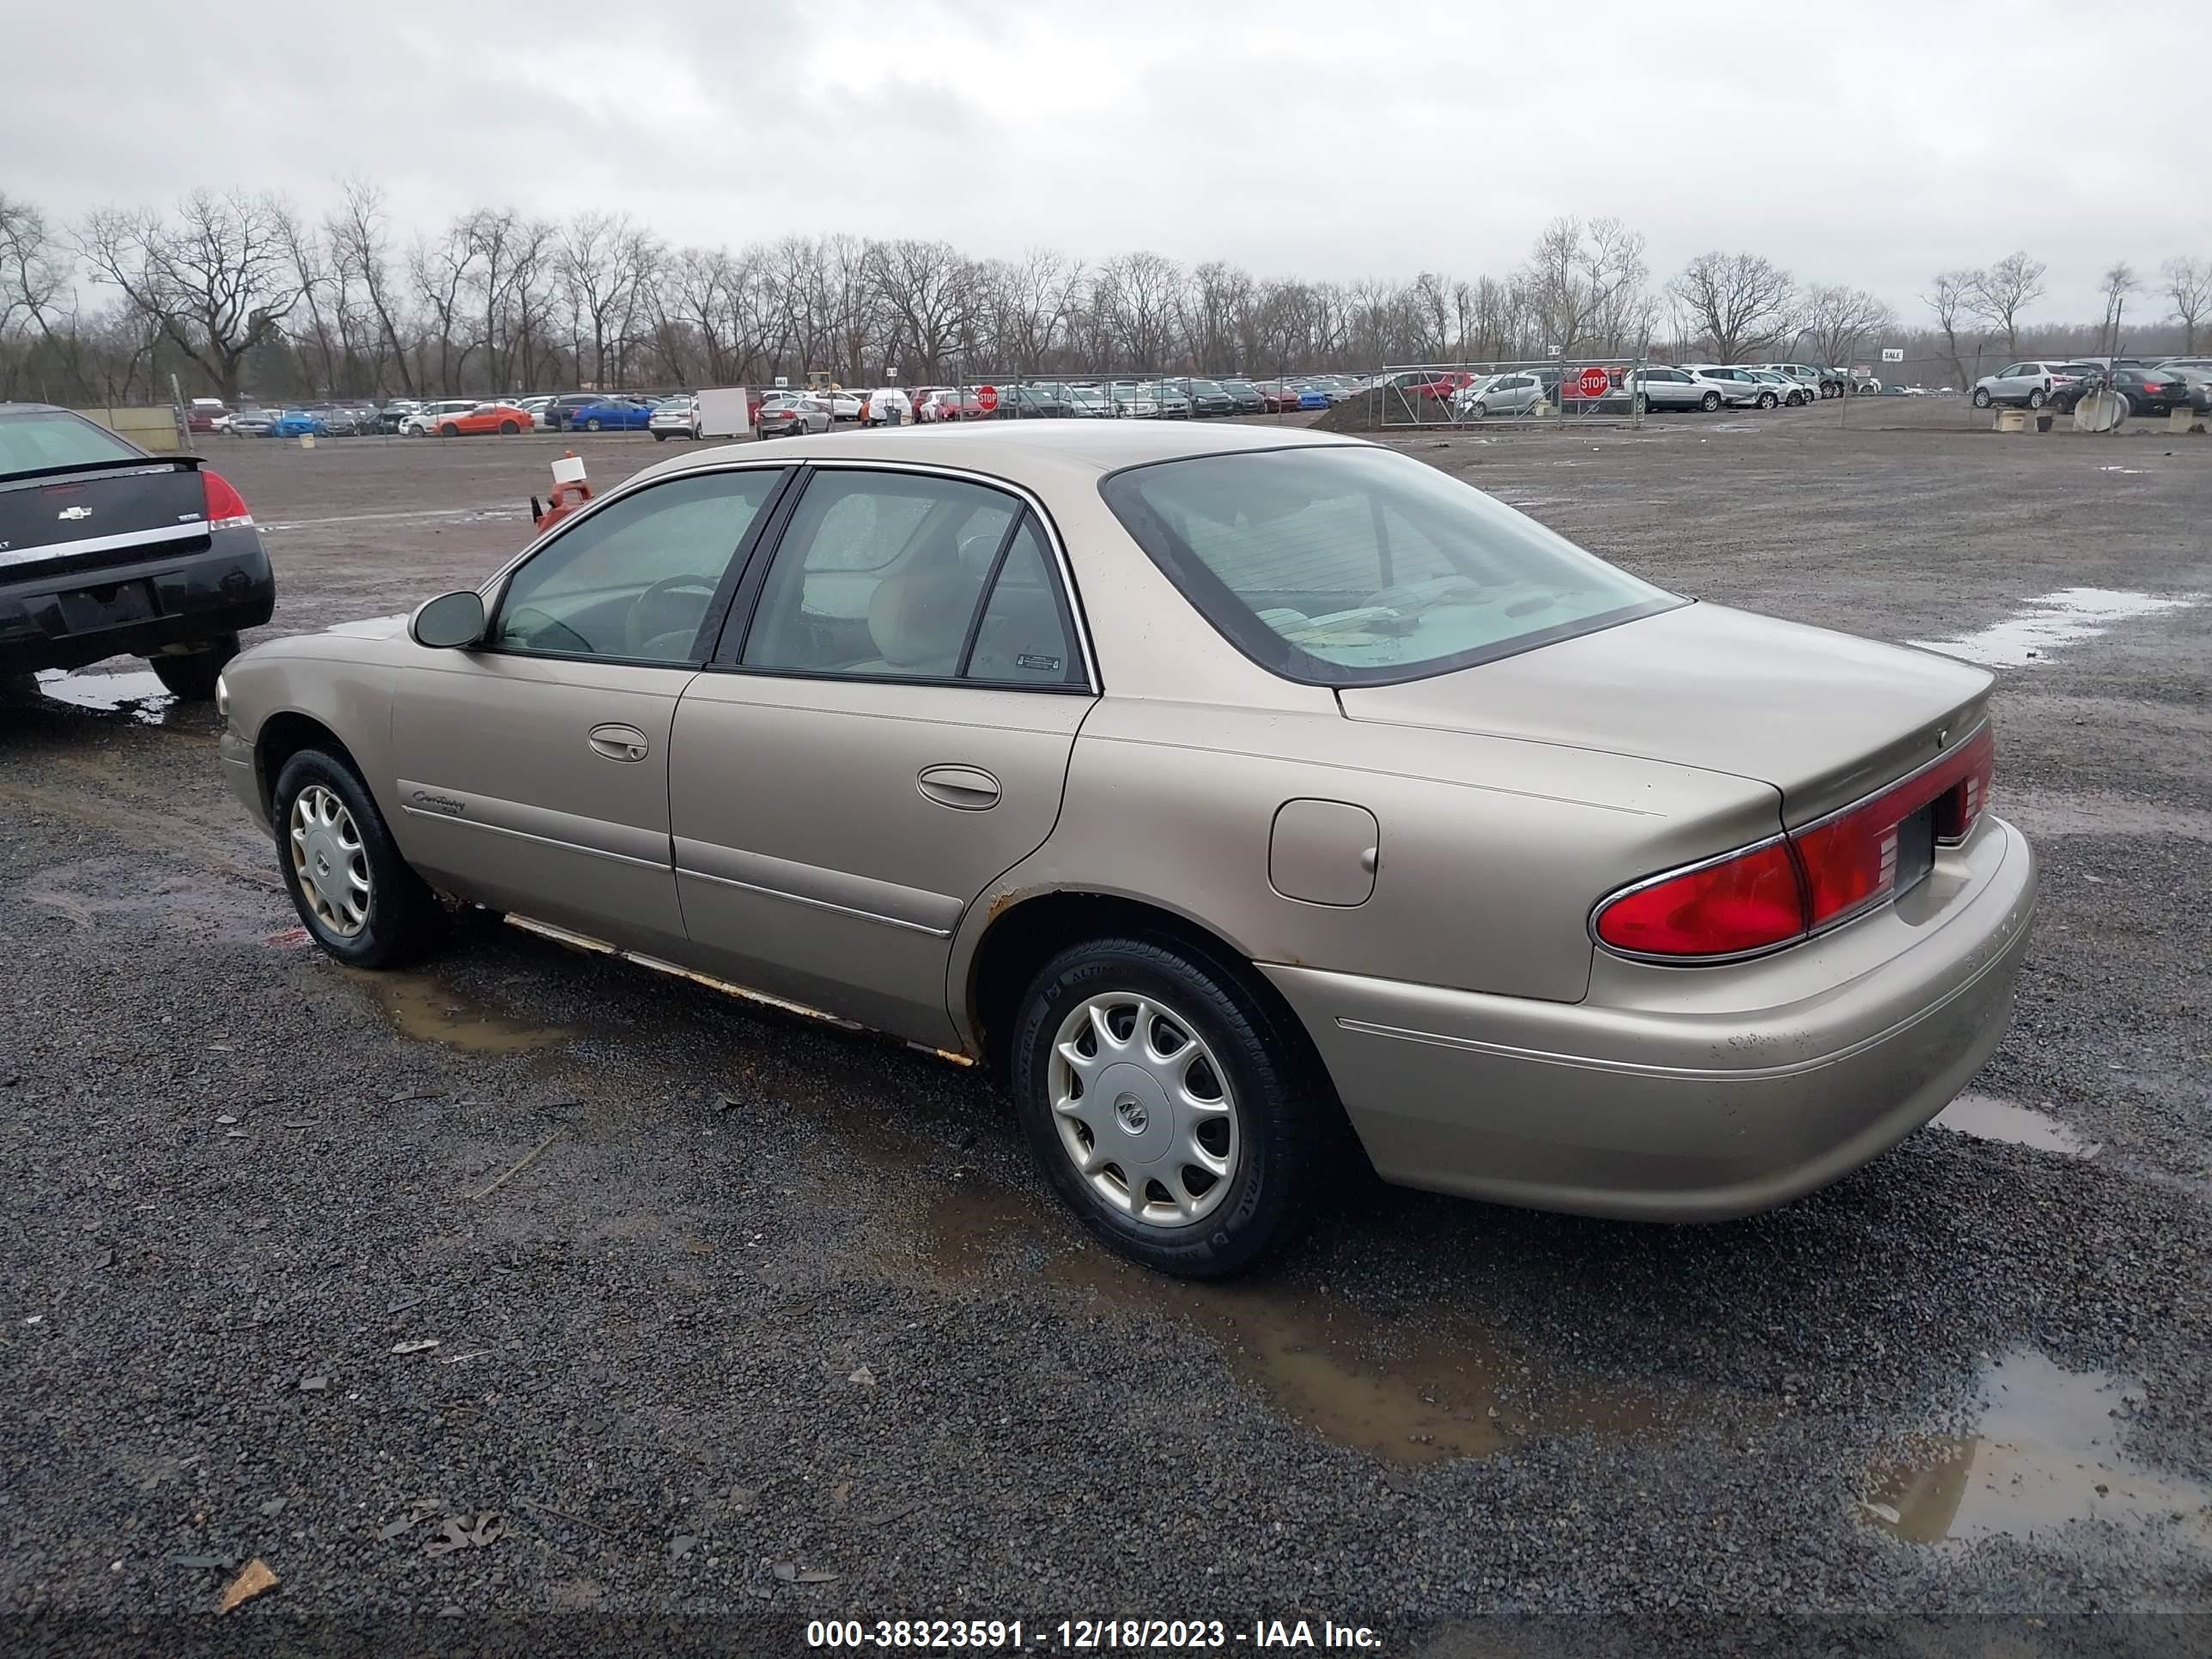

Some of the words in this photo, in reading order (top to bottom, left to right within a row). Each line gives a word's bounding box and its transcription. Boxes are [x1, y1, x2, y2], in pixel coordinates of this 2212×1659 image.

[1884, 351, 1900, 360] SALE
[1581, 376, 1607, 389] STOP
[979, 392, 997, 404] STOP
